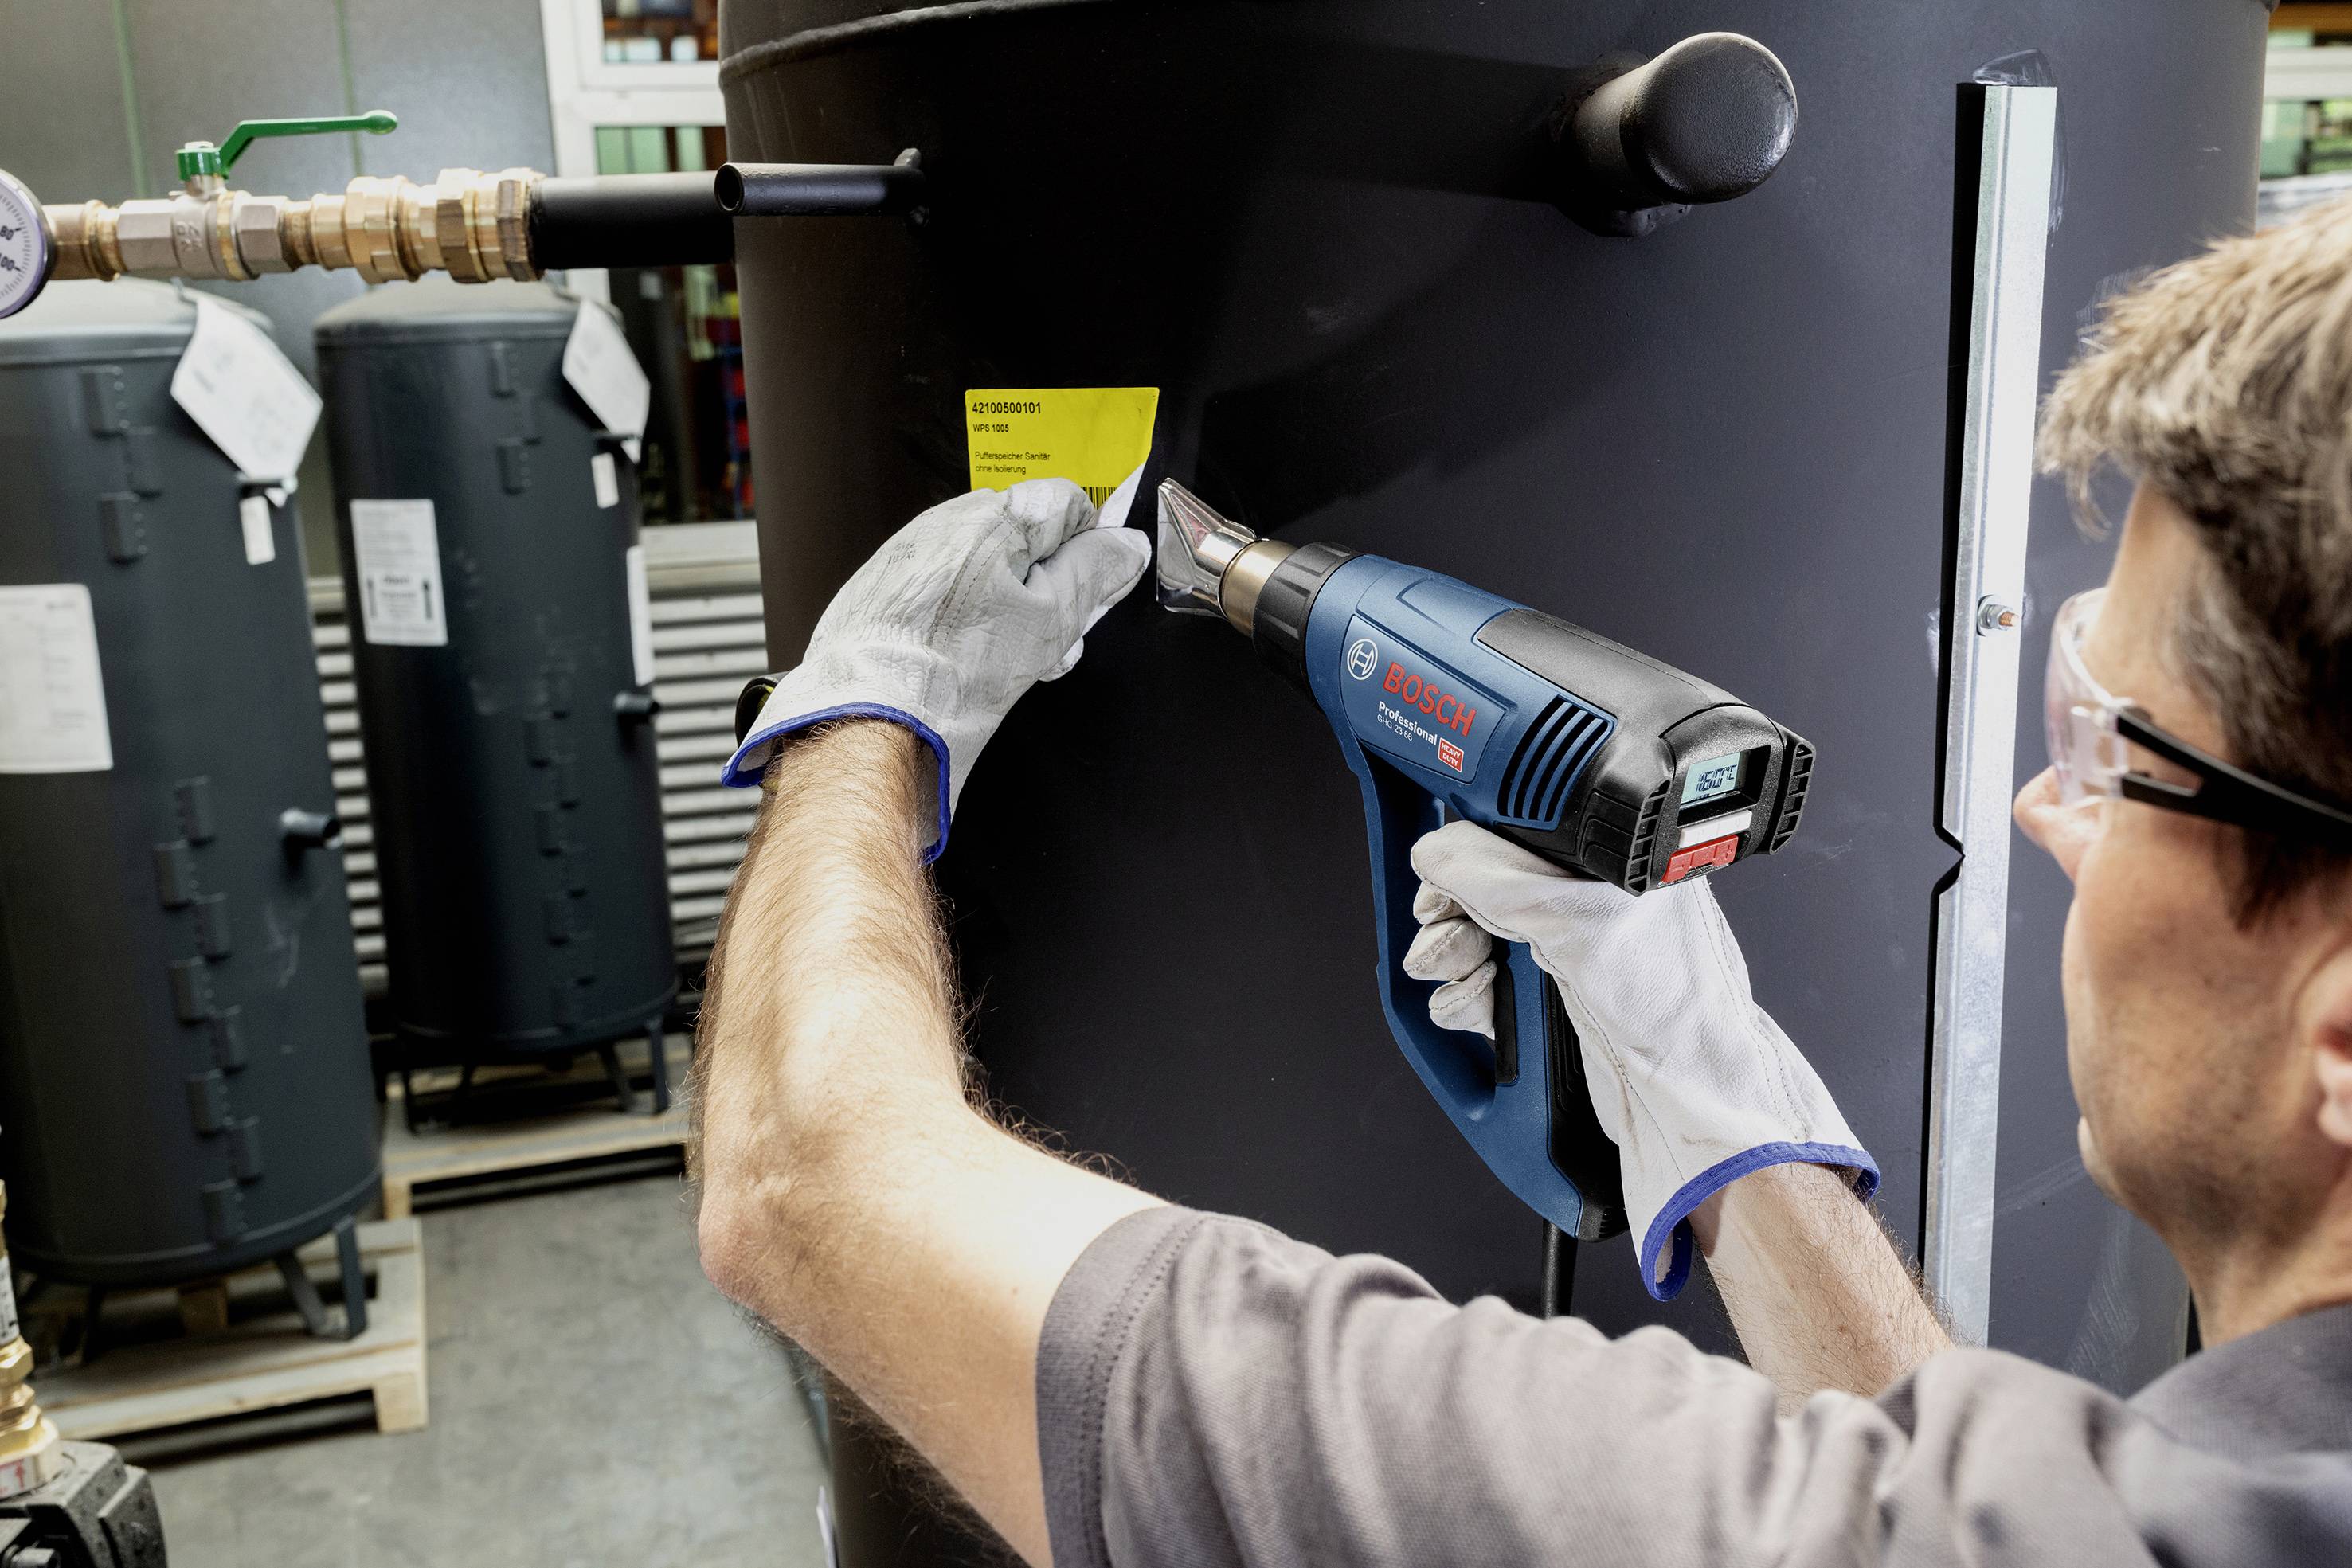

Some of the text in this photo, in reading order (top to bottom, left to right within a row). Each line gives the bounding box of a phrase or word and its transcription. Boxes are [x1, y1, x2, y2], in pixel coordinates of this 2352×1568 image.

[0, 225, 14, 240] 80
[0, 252, 15, 271] 00
[972, 402, 1041, 413] 42100500101
[973, 424, 1009, 432] WPS 1005
[975, 451, 1051, 462] Pufferspeicher Sanitär
[993, 464, 1027, 475] Isolierung
[1383, 662, 1477, 737] BOSCH
[1377, 714, 1413, 741] GHG 23-66
[1378, 701, 1438, 746] Professional
[1441, 742, 1461, 759] HEAVY
[1442, 753, 1458, 767] DUTY
